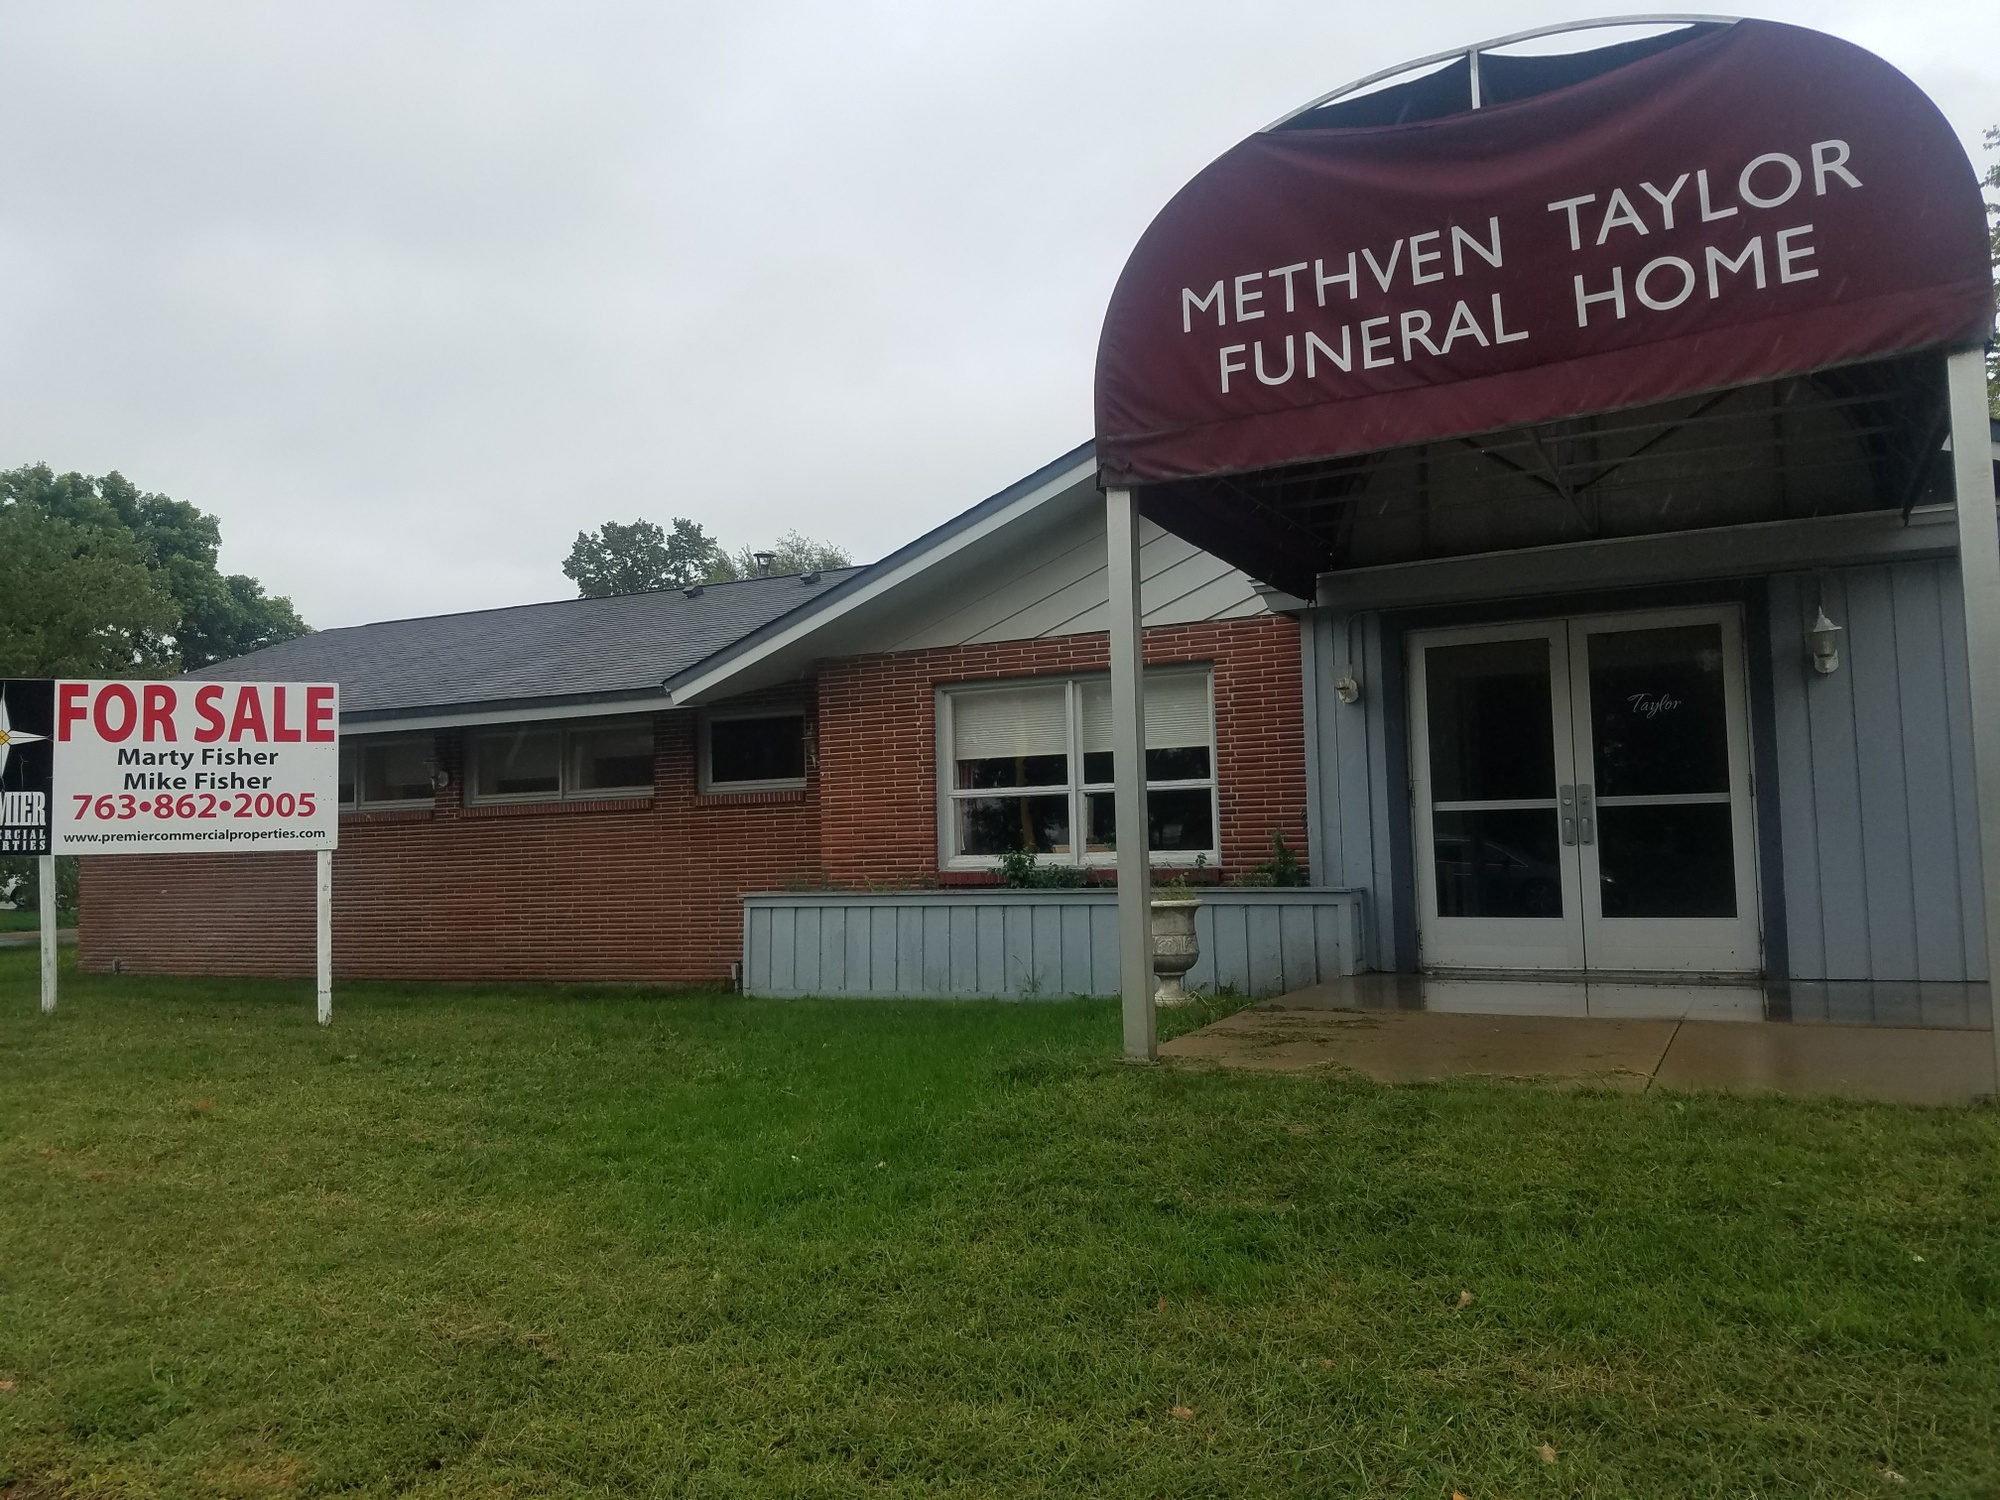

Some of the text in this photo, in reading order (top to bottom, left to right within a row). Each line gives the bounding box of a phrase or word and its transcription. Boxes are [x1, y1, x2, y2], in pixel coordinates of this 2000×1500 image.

[1181, 139, 1864, 334] METHVEN TAYLOR
[1219, 223, 1819, 394] FUNERAL HOME
[58, 683, 336, 744] FOR SALE
[1627, 692, 1682, 720] Taylor
[117, 746, 280, 771] Marty Fisher
[123, 770, 274, 791] Mike Fisher
[63, 828, 326, 844] www.premiercommercialproperties.com
